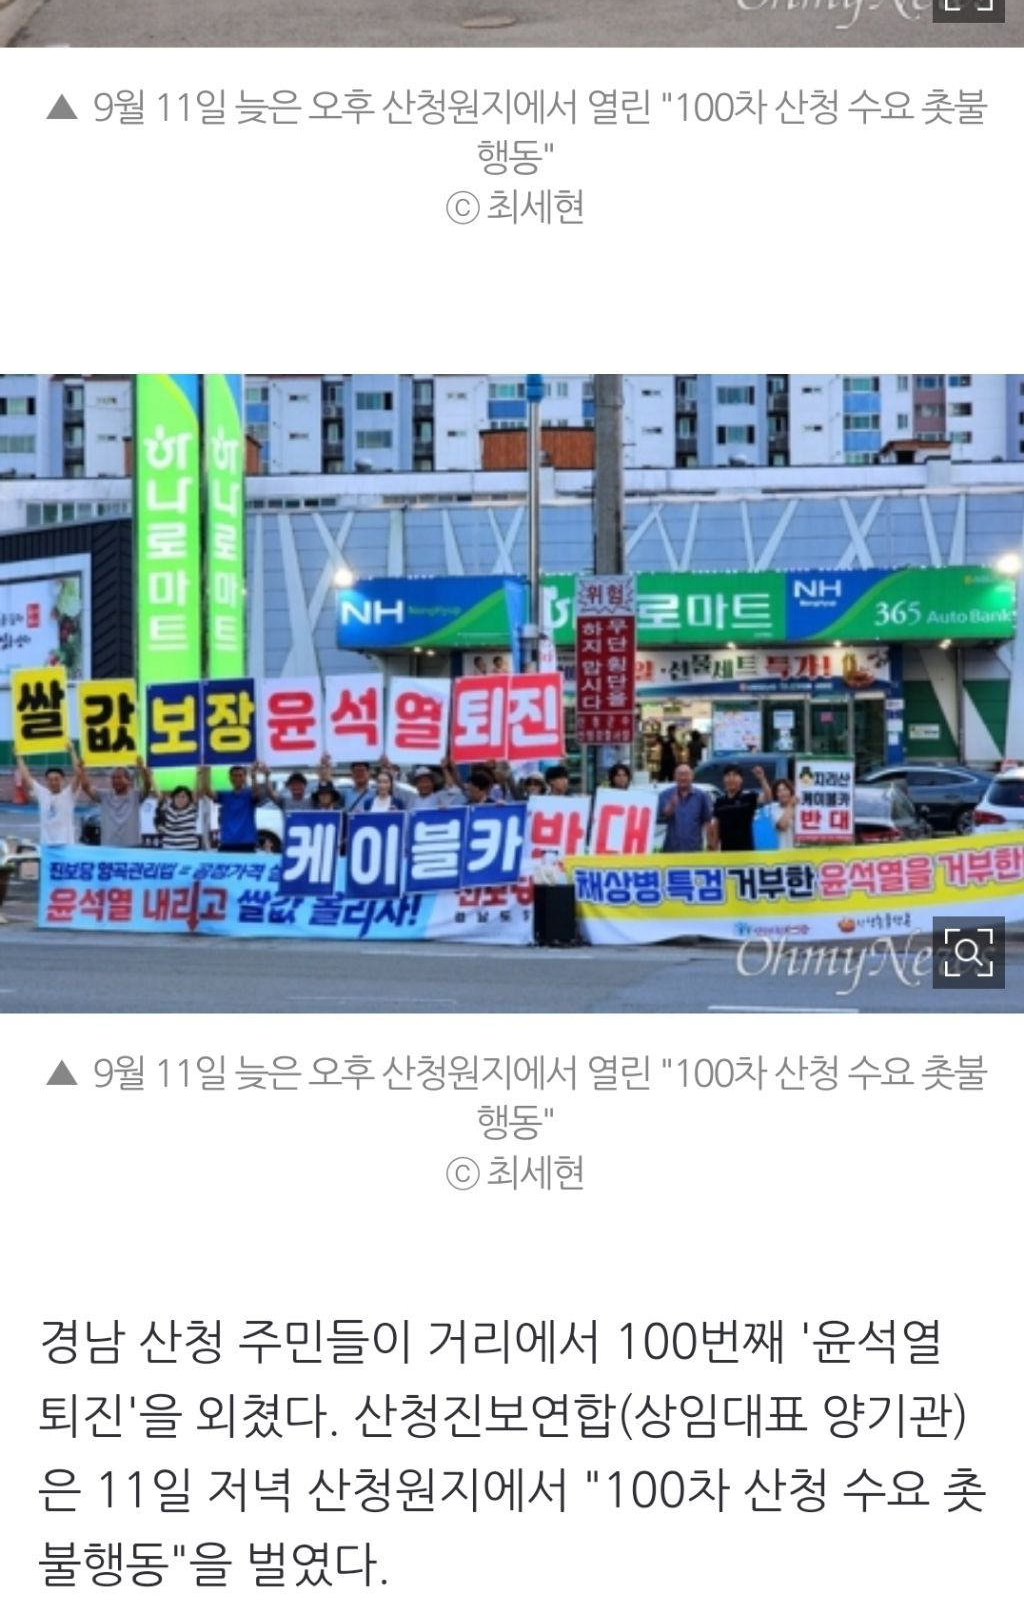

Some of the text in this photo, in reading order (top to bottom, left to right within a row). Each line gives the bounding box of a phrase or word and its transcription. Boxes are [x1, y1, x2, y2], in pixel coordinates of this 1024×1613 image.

[94, 89, 987, 125] 9월 11일 늦은 오후 산청원지에서 열린 "100차 산청 수요 촛불
[478, 140, 553, 175] 행동"
[488, 189, 583, 224] 최세현
[145, 424, 192, 651] 하나로마트
[212, 425, 241, 652] 하나로마트
[587, 584, 624, 604] 위험
[794, 579, 841, 598] NH
[341, 599, 404, 626] NH
[874, 599, 1011, 626] 365 Auto Bank
[582, 621, 602, 653] 하지
[765, 653, 832, 680] 특가!
[455, 685, 559, 747] 퇴진
[814, 771, 850, 787] 지리산
[283, 816, 524, 886] 케이블카
[667, 868, 724, 903] 특검
[729, 864, 814, 900] 거부한
[820, 857, 932, 897] 윤석열을
[46, 887, 132, 922] 윤석열
[94, 1055, 987, 1091] 9월 11일 늦은 오후 산청원지에서 열린 "100차 산청 수요 촛불
[478, 1106, 553, 1141] 행동"
[488, 1155, 583, 1190] 최세현
[42, 1320, 939, 1364] 경남 산청 주민들이 거리에서 100번째 '윤석열
[40, 1393, 965, 1440] 퇴진'을 외쳤다. 산청진보연합(상임대표 양기관)
[39, 1468, 986, 1513] 은 11일 저녁 산청원지에서 "100차 산청 수요 촛
[39, 1542, 387, 1587] 불행동"을 벌였다.
